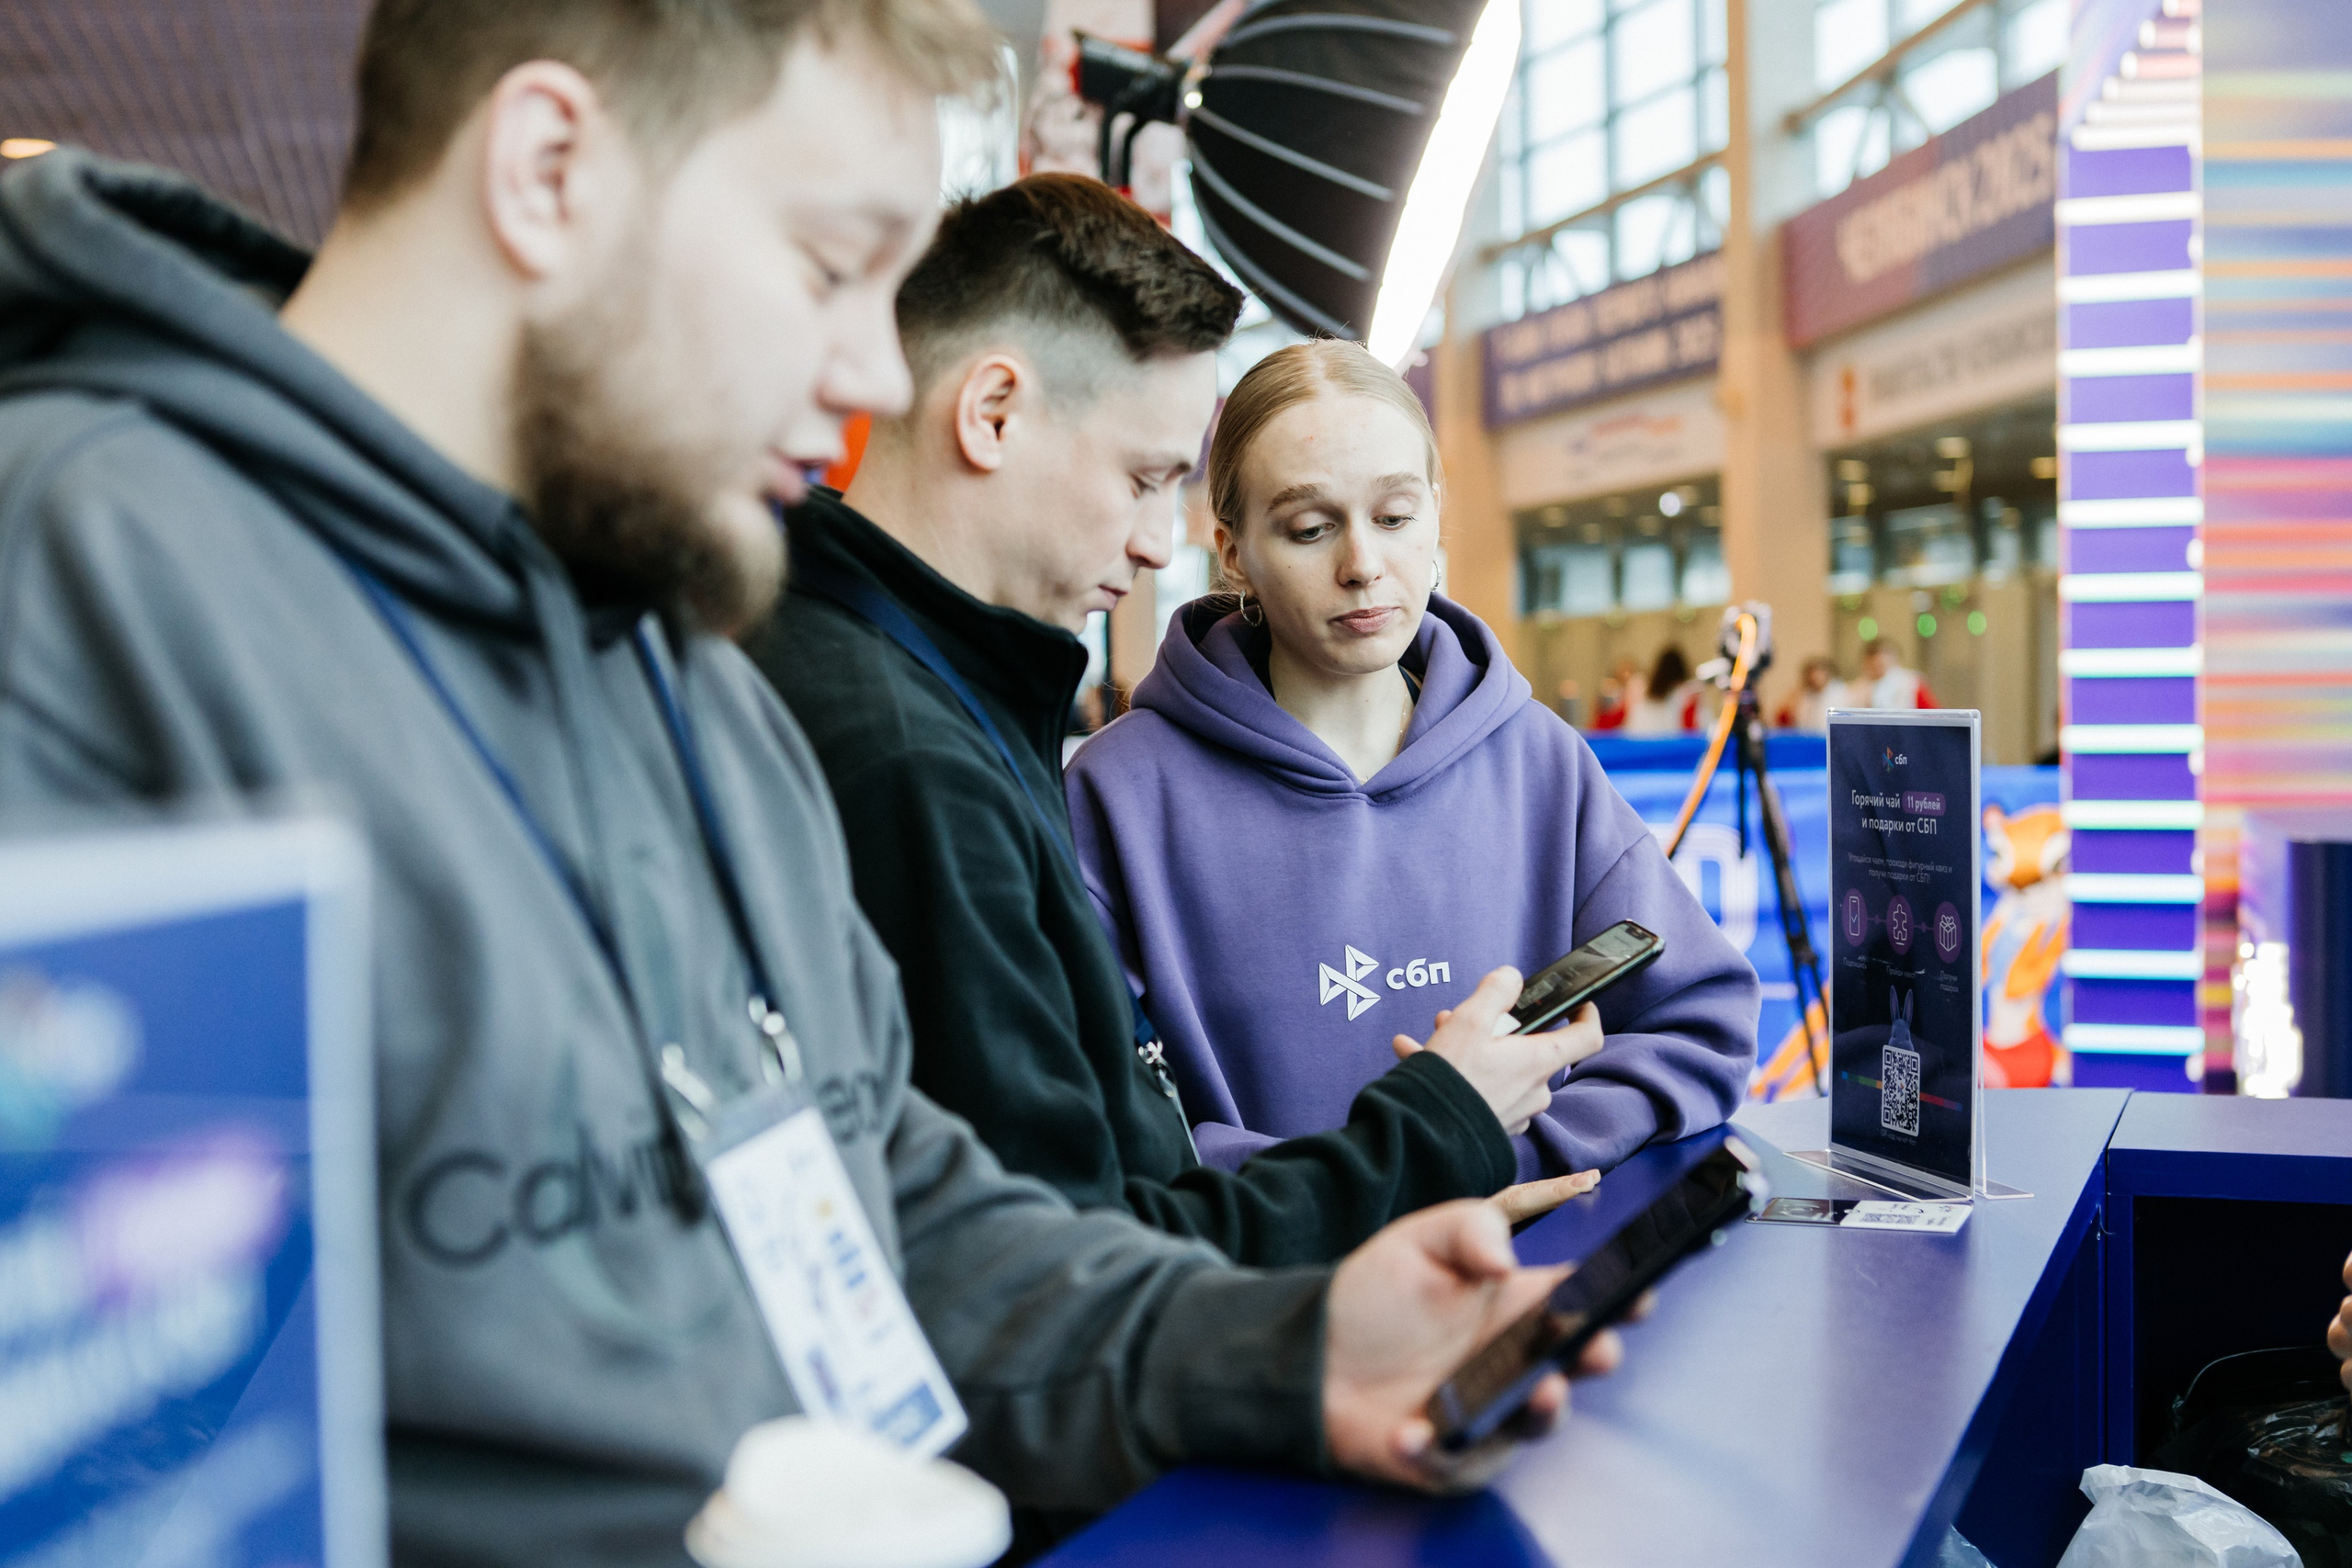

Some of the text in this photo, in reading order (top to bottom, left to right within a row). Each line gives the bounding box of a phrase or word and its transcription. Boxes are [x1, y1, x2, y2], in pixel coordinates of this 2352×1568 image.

[1894, 753, 1907, 765] сбп
[1851, 789, 1941, 812] Горячий чай 11 рублей
[1861, 817, 1937, 836] и подарки от СБП
[1908, 859, 1935, 872] фигурный
[1868, 869, 1887, 880] получи
[1887, 871, 1908, 882] подарки
[1916, 872, 1930, 884] СБП!
[1385, 957, 1452, 991] сбп
